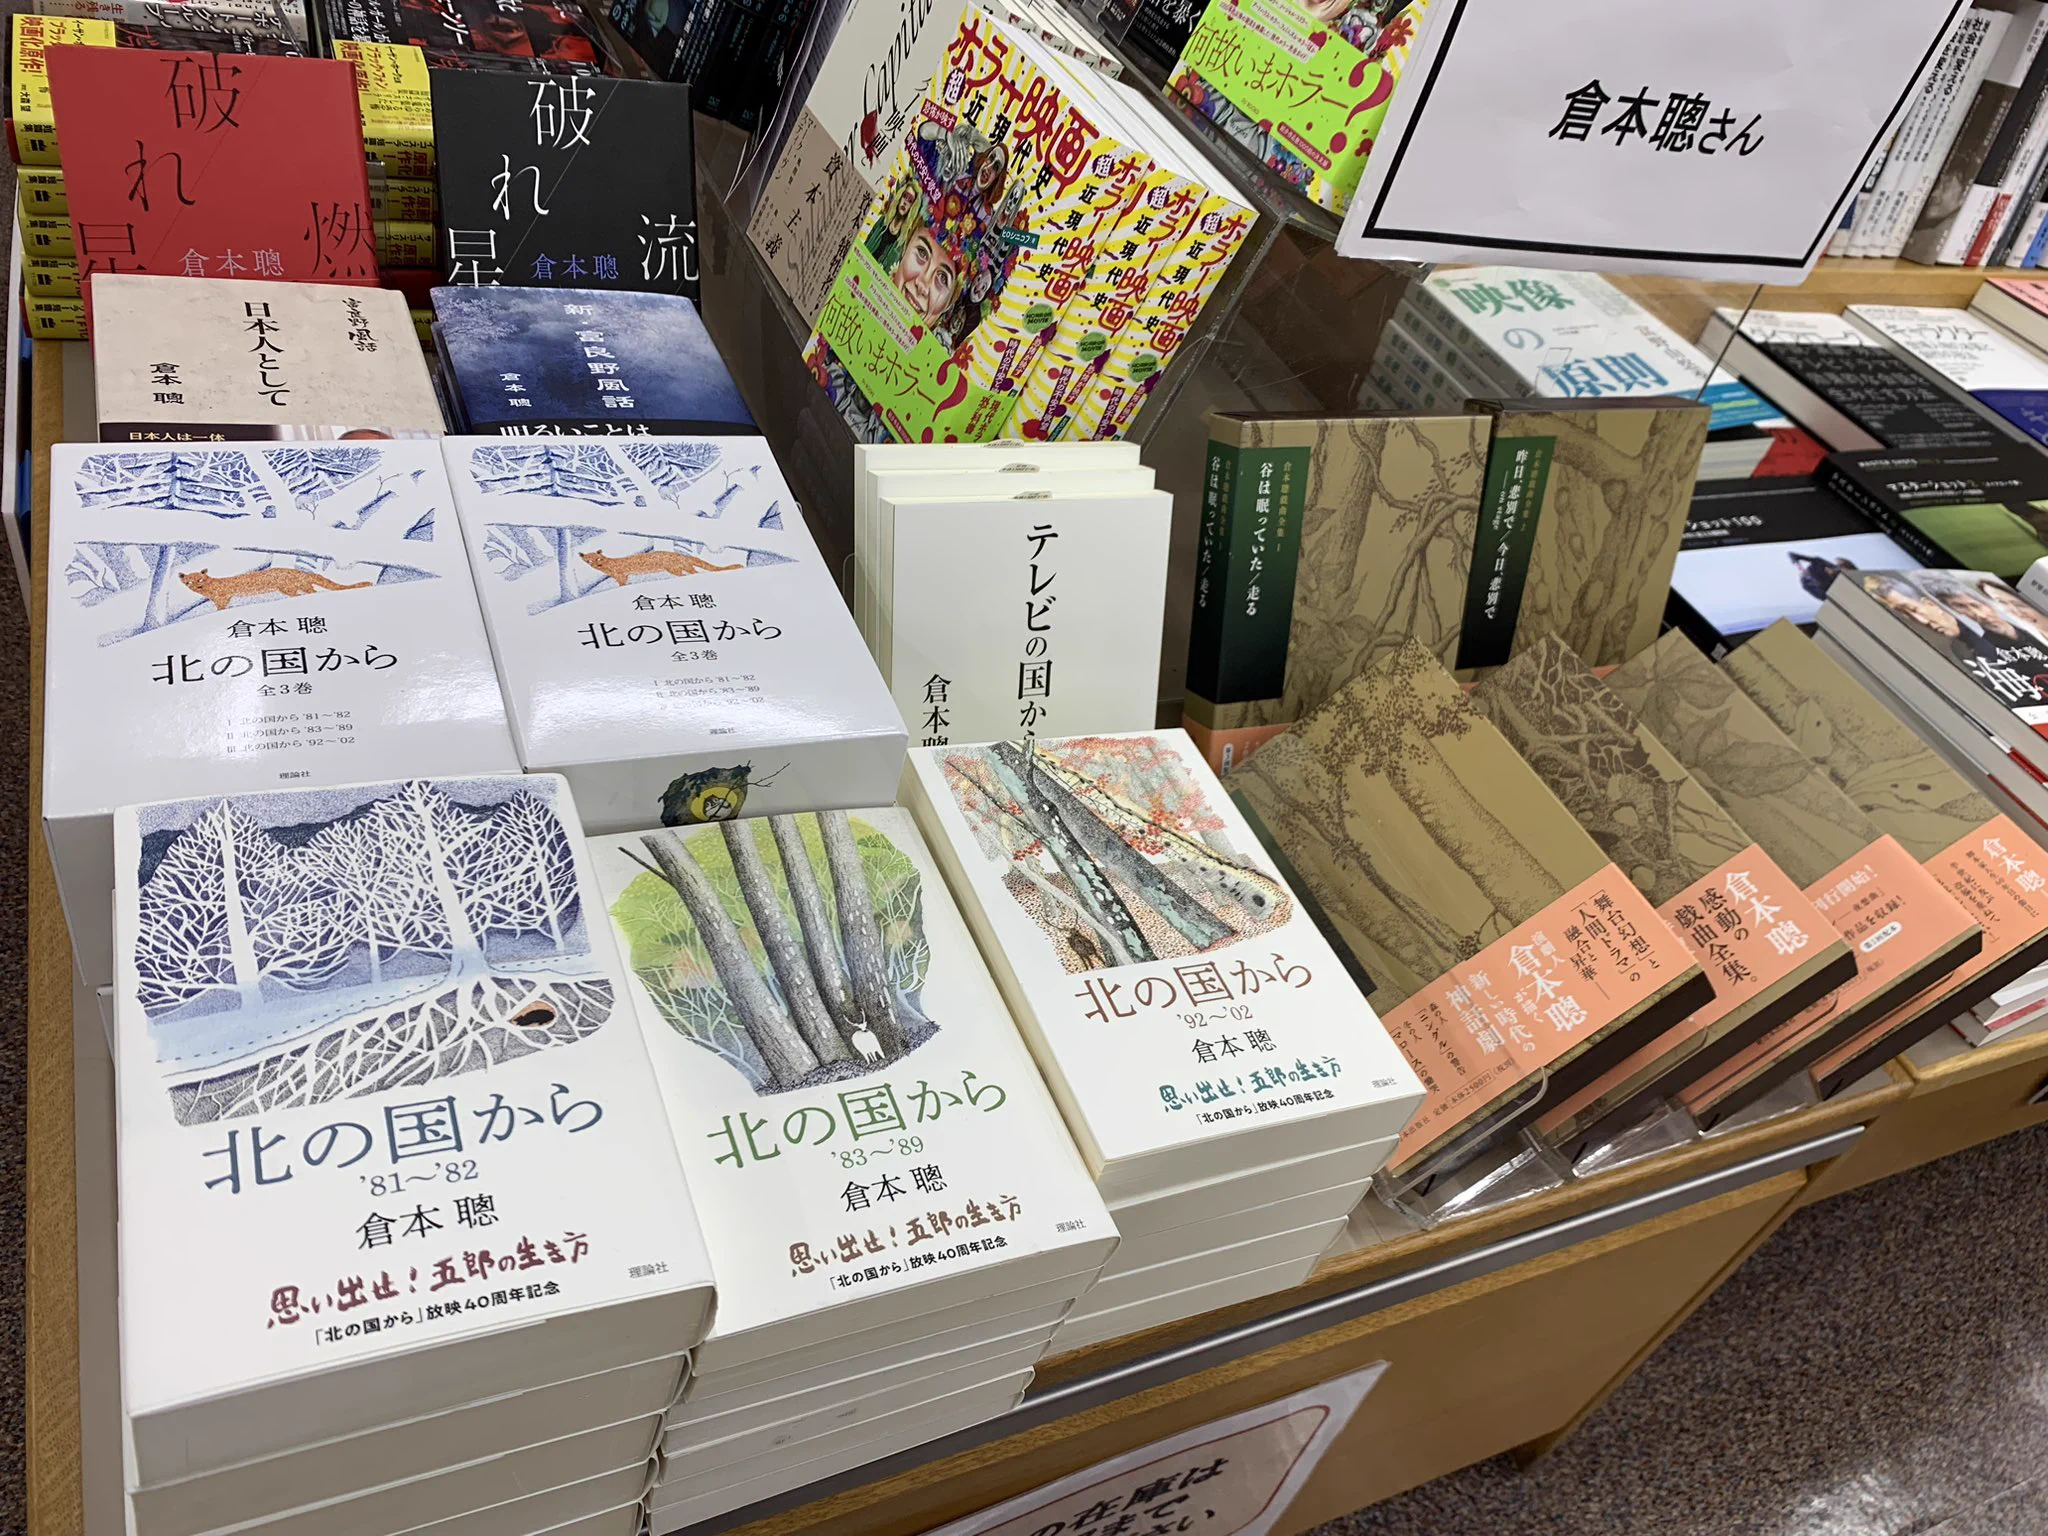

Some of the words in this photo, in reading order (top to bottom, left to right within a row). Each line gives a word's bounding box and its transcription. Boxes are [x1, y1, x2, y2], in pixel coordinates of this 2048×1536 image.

[1548, 78, 1765, 156] 倉本聰さん
[178, 248, 285, 277] 倉本聰
[530, 253, 620, 280] 倉本聰
[1451, 279, 1575, 317] 映像
[243, 301, 291, 407] 日本人として
[563, 303, 635, 409] 新・富良野風話
[1503, 327, 1545, 350] の
[150, 362, 185, 405] 倉本聰
[500, 372, 532, 407] 倉本聰
[1537, 352, 1669, 397] 原則
[632, 594, 717, 611] 倉本聰
[227, 616, 328, 639] 倉本聰
[577, 617, 782, 649] 北の国から
[152, 644, 398, 685] 北の国から
[671, 649, 718, 662] 全3巻
[257, 682, 313, 697] 全3巻
[1981, 837, 2046, 894] 倉本聰
[1698, 886, 1750, 942] 感動の
[1722, 869, 1811, 956] 倉本聰
[1074, 952, 1313, 1024] 北の国から
[1507, 942, 1589, 1033] 倉本聰
[1445, 984, 1507, 1056] 神話劇
[1191, 1028, 1277, 1065] 倉本聰
[706, 1070, 1007, 1169] 北の国から
[1195, 1088, 1335, 1125] 「北の国から」放映40周年記念
[201, 1083, 603, 1195] 北の国から
[840, 1163, 948, 1213] 倉本聰
[355, 1194, 500, 1250] 倉本聰
[828, 1234, 1009, 1292] 「北の国から」放映40周年記念
[313, 1279, 561, 1346] 「北の国から」放映40周年記念
